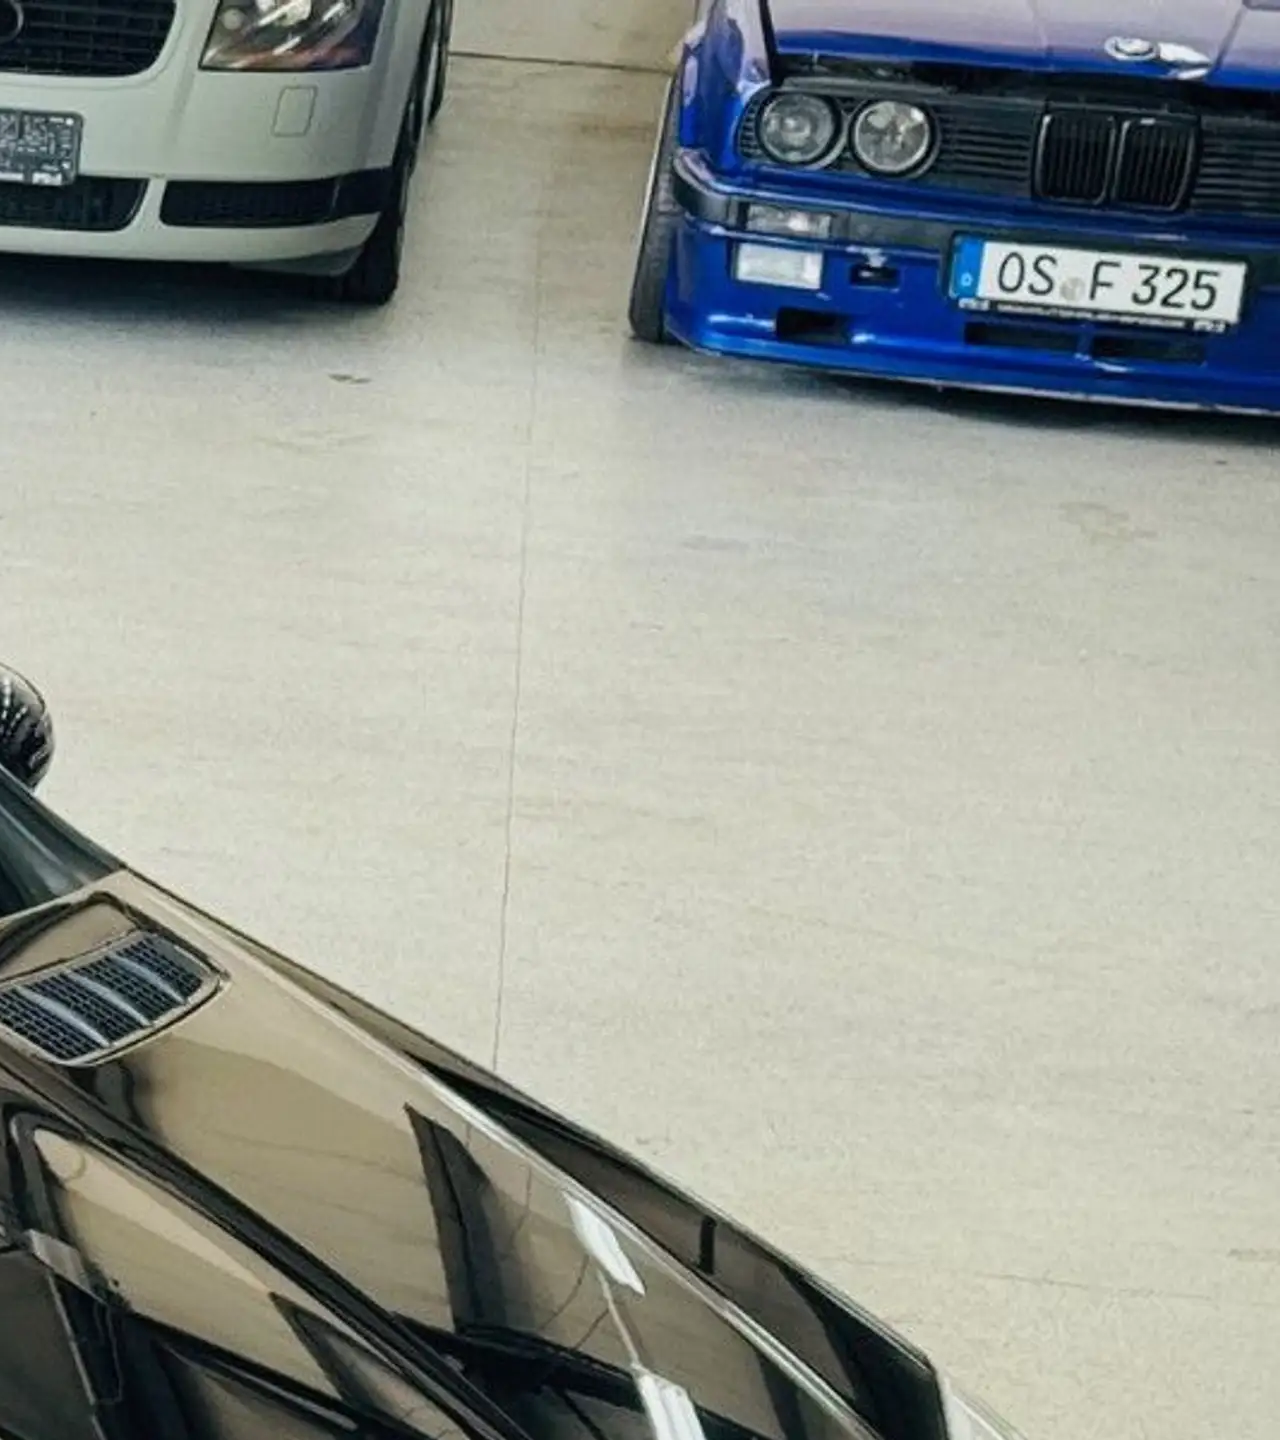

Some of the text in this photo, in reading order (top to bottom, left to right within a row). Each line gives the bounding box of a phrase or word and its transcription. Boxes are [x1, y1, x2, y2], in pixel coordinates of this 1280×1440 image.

[998, 251, 1221, 312] OS F 325
